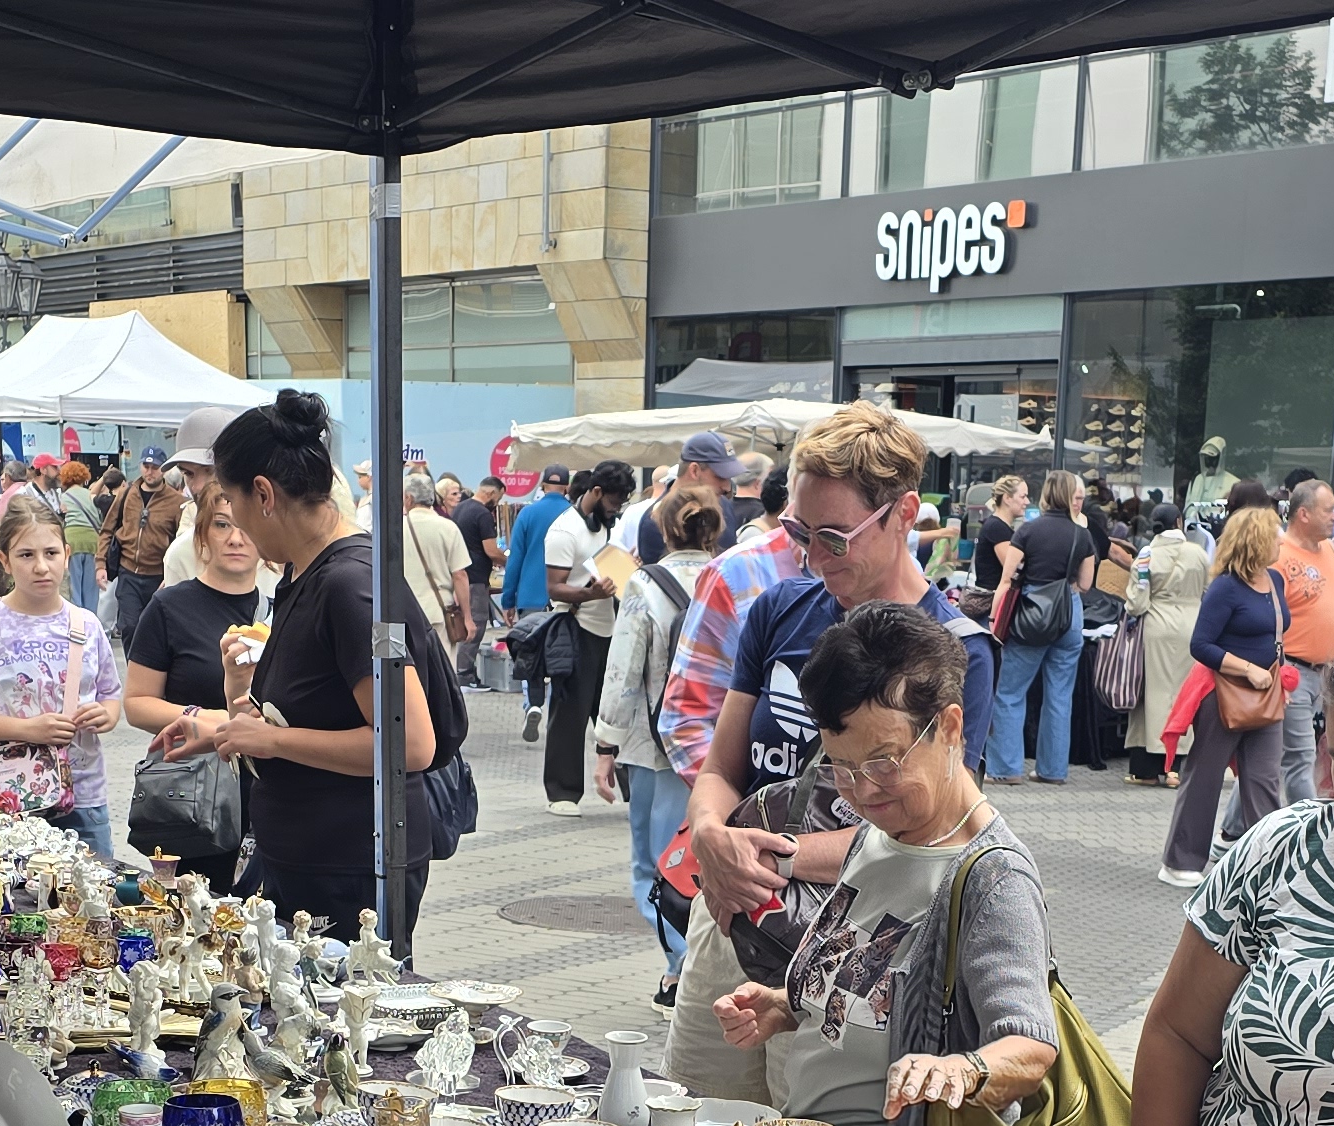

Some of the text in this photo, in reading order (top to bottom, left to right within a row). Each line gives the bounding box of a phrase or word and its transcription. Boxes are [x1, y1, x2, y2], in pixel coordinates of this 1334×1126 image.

[875, 201, 1007, 293] snipes
[401, 444, 424, 460] dm
[751, 741, 805, 777] adi
